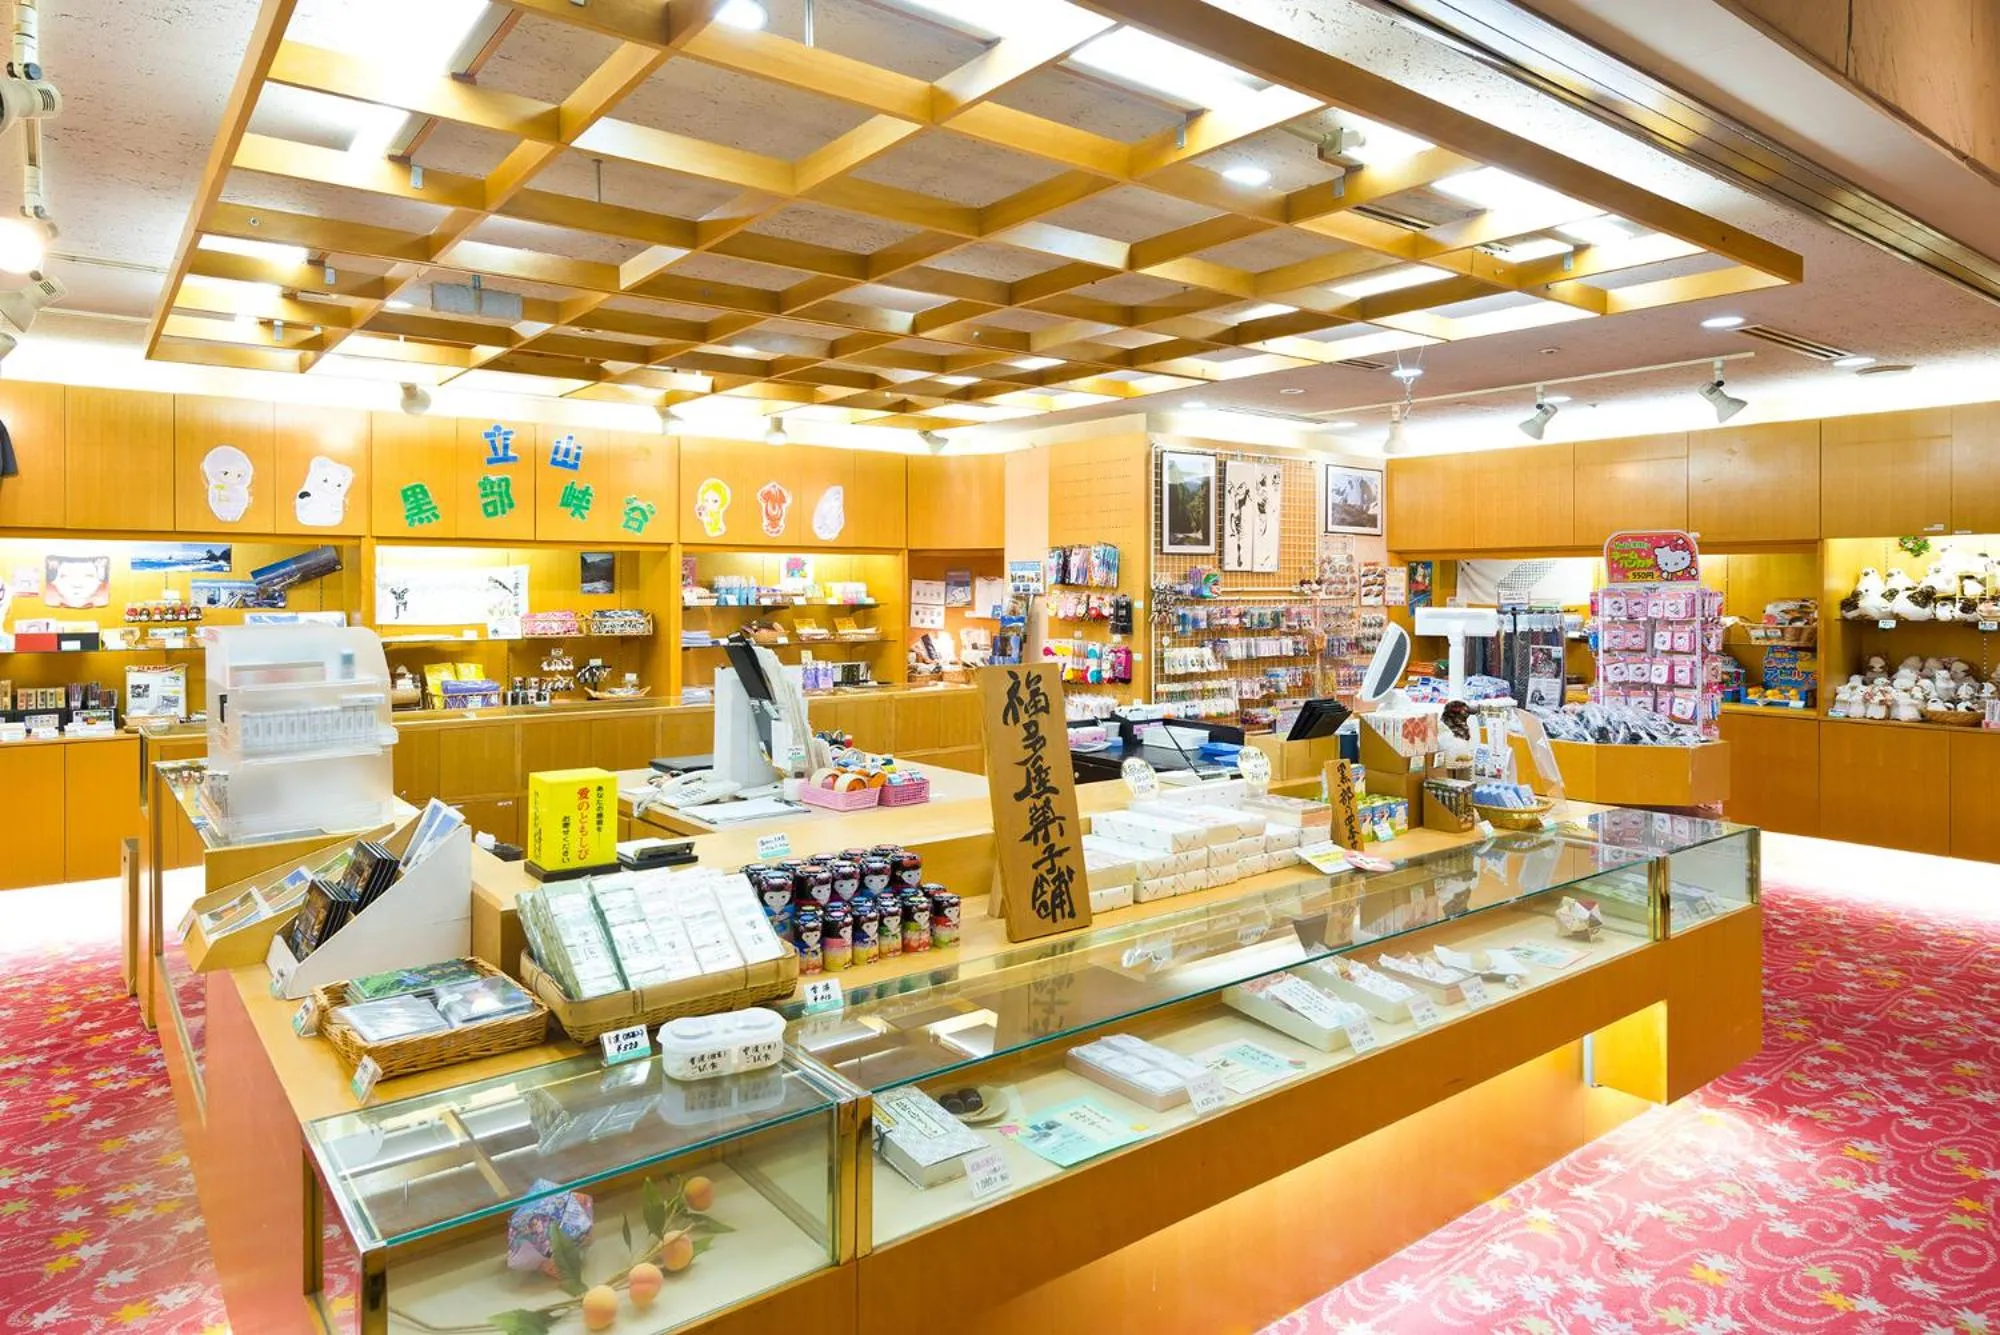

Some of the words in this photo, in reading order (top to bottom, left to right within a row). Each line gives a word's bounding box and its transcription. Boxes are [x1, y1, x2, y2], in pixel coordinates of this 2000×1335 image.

[483, 424, 584, 471] 立山
[400, 474, 657, 535] 黒部峡谷
[577, 786, 592, 861] 愛のともしび
